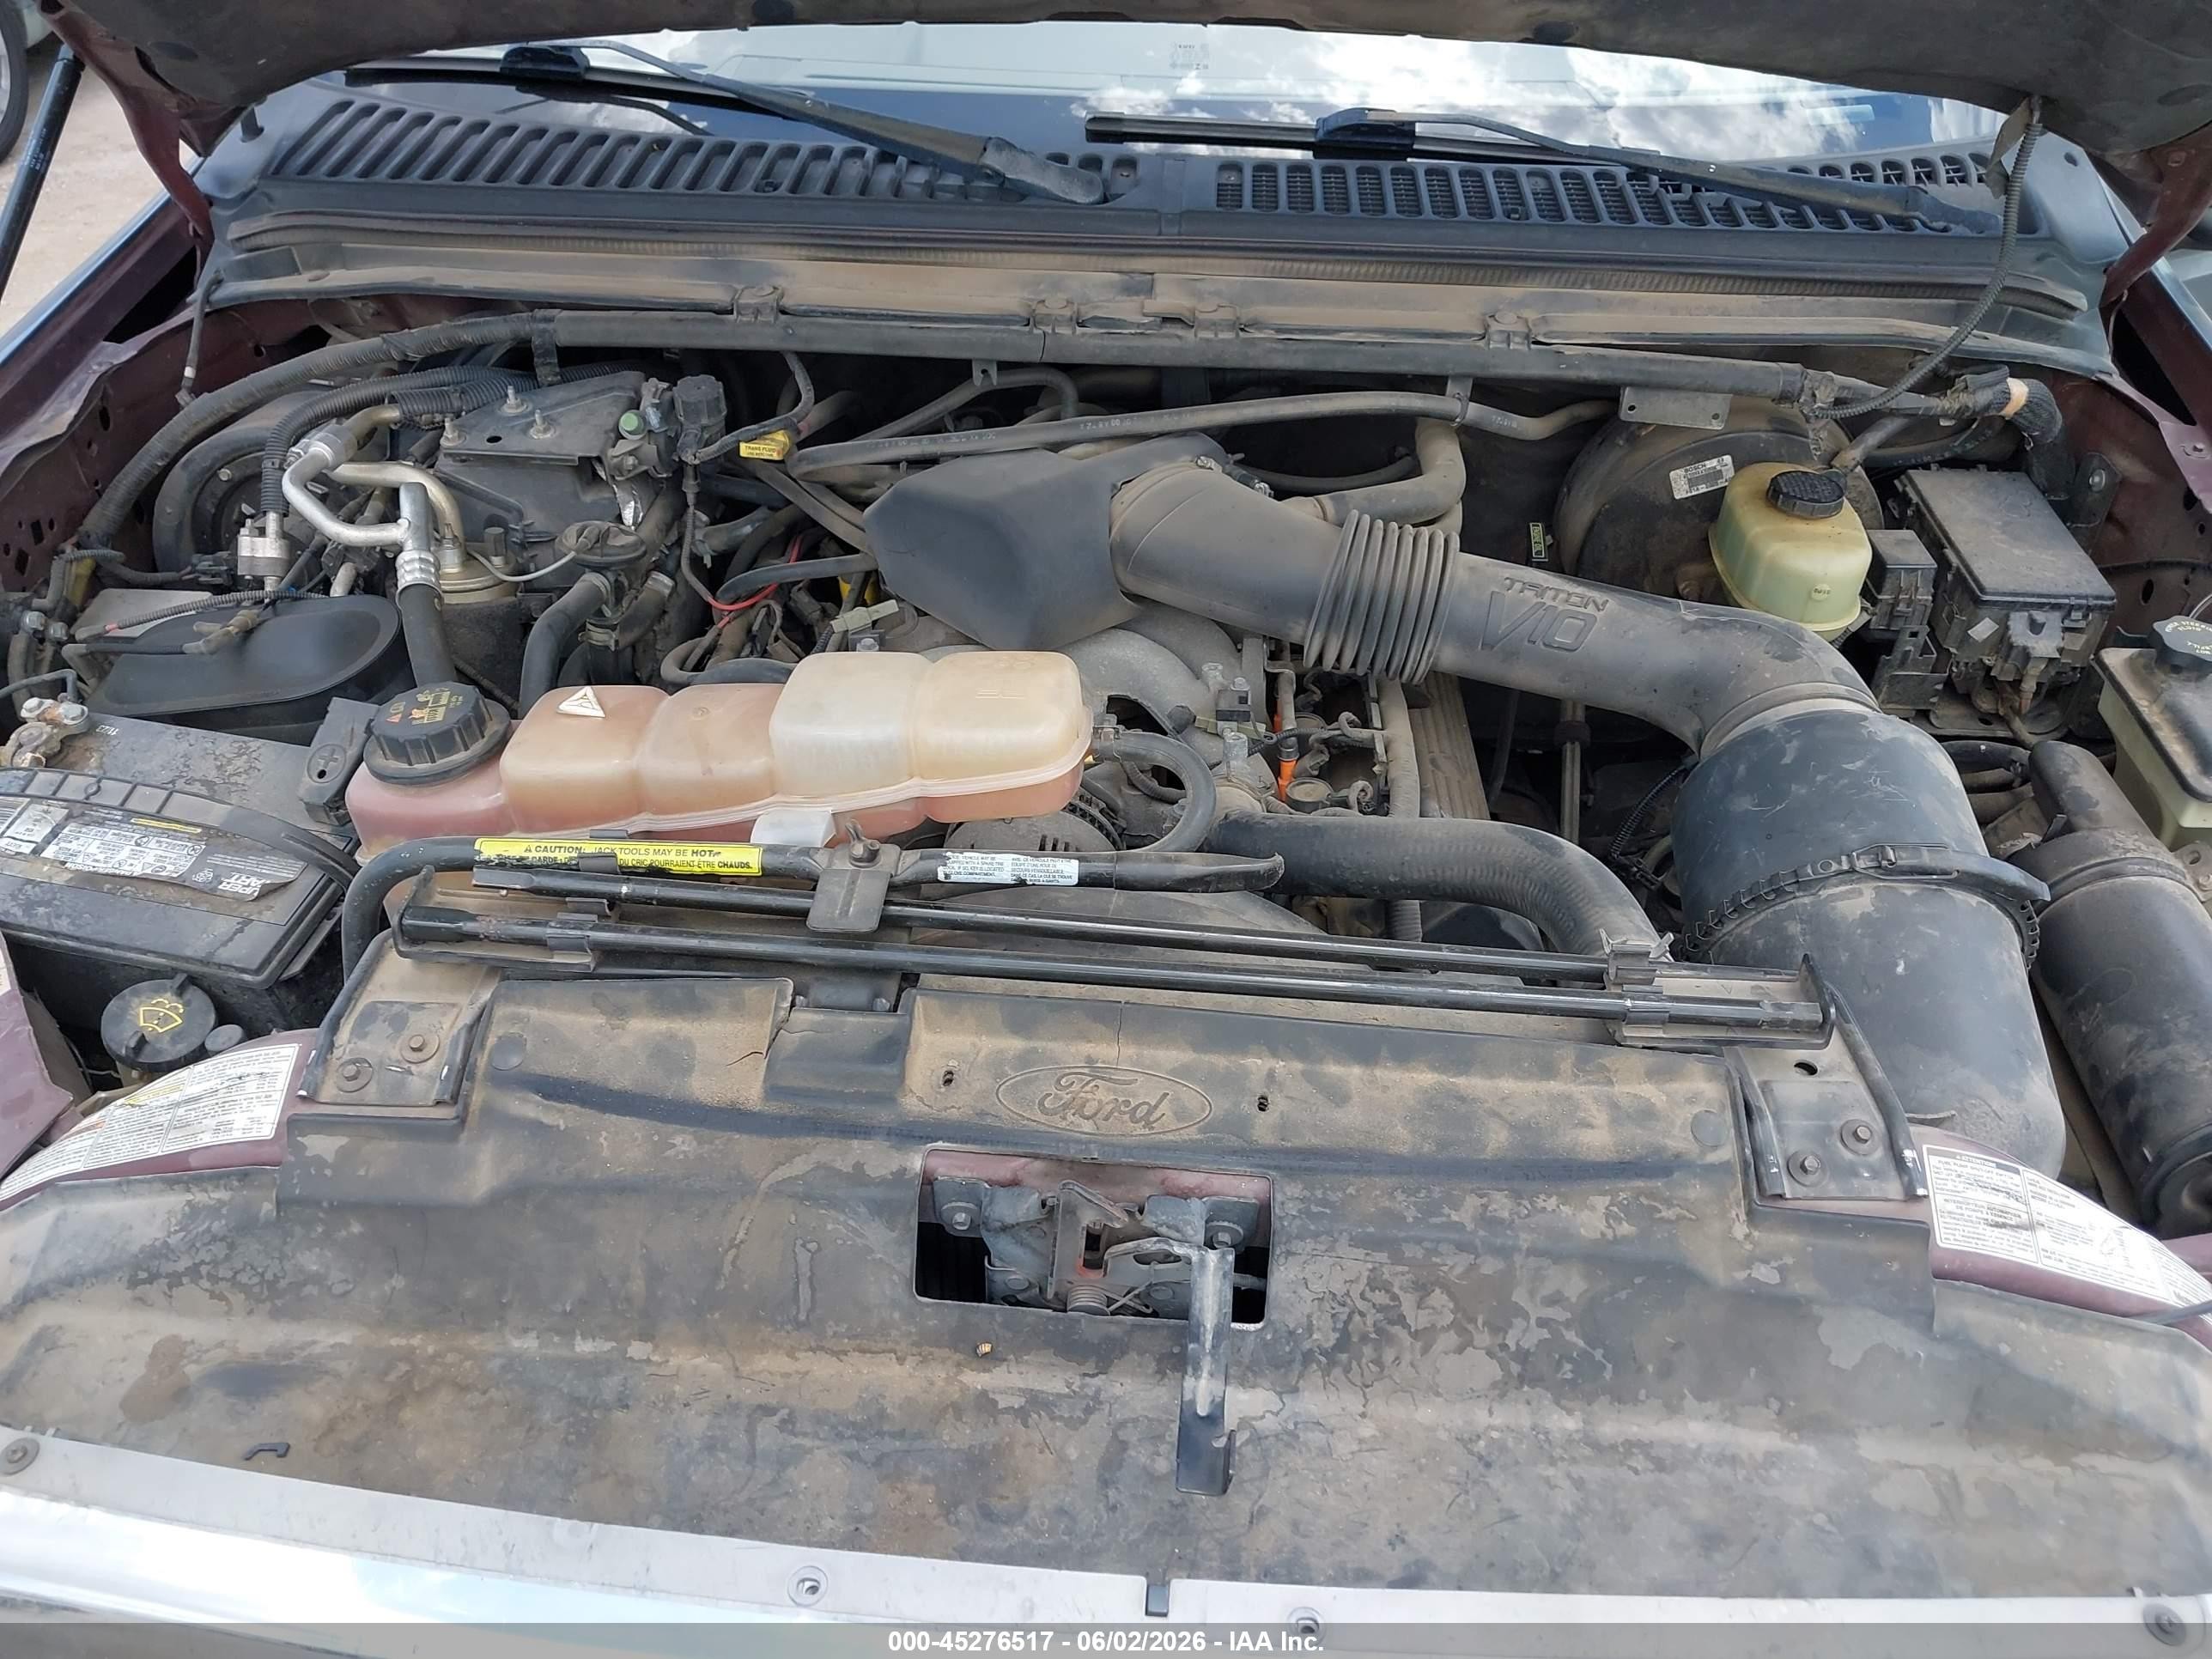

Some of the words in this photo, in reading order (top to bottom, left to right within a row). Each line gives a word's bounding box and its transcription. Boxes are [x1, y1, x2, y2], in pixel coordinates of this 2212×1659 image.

[1504, 576, 1609, 612] TRITON
[1480, 591, 1597, 653] V10
[535, 845, 586, 854] CAUTION:
[618, 848, 650, 856] TOOLS
[650, 860, 695, 868] POURRAIENT
[218, 881, 261, 895] UPER
[1036, 1071, 1171, 1125] Ford
